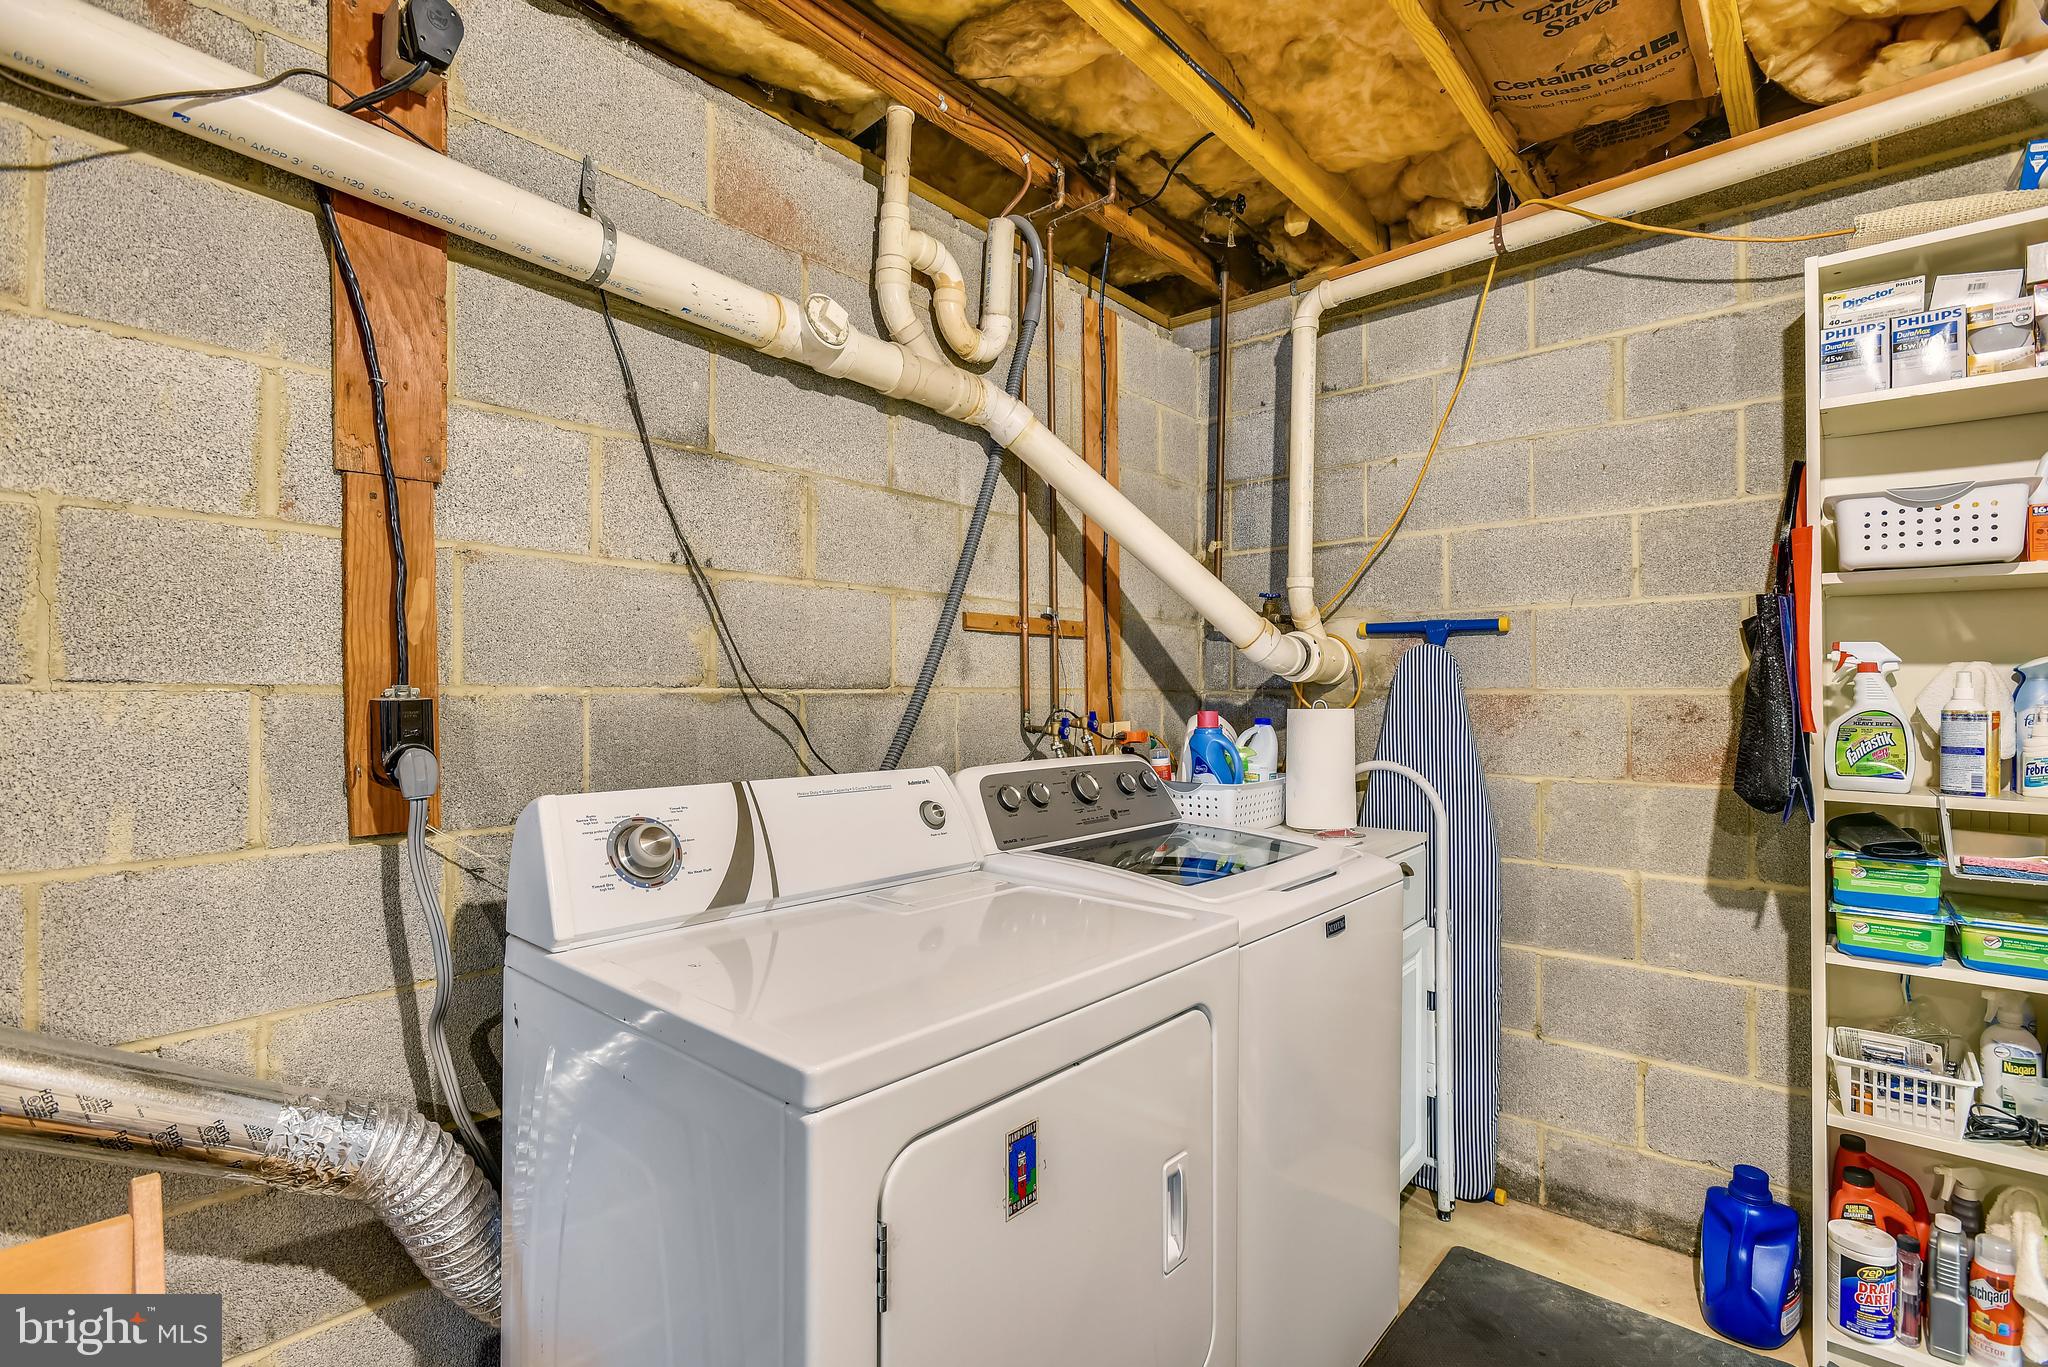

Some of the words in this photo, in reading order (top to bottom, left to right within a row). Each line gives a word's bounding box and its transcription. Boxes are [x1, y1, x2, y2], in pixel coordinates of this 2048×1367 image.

[1493, 45, 1648, 91] CertainTeed
[1540, 84, 1592, 98] Glass
[1598, 47, 1690, 87] Insulation
[1558, 92, 1601, 105] Thermal
[1604, 67, 1675, 96] Performance
[250, 142, 288, 159] AMPP
[312, 164, 335, 179] PVC
[342, 176, 365, 190] 1120
[419, 206, 440, 219] 260
[441, 214, 456, 225] PSI
[458, 221, 497, 241] ASTM-D
[1896, 279, 1923, 287] PHILIPS
[1843, 287, 1894, 309] Director
[1897, 309, 1962, 328] PHILIPS
[1825, 322, 1886, 340] PHILIPS
[1897, 328, 1930, 339] DuraMax
[2032, 506, 2048, 514] 16
[1846, 731, 1896, 767] fantastik
[2003, 1061, 2036, 1076] Niagara
[1859, 1280, 1895, 1294] DRAIN
[1855, 1292, 1888, 1305] CARE
